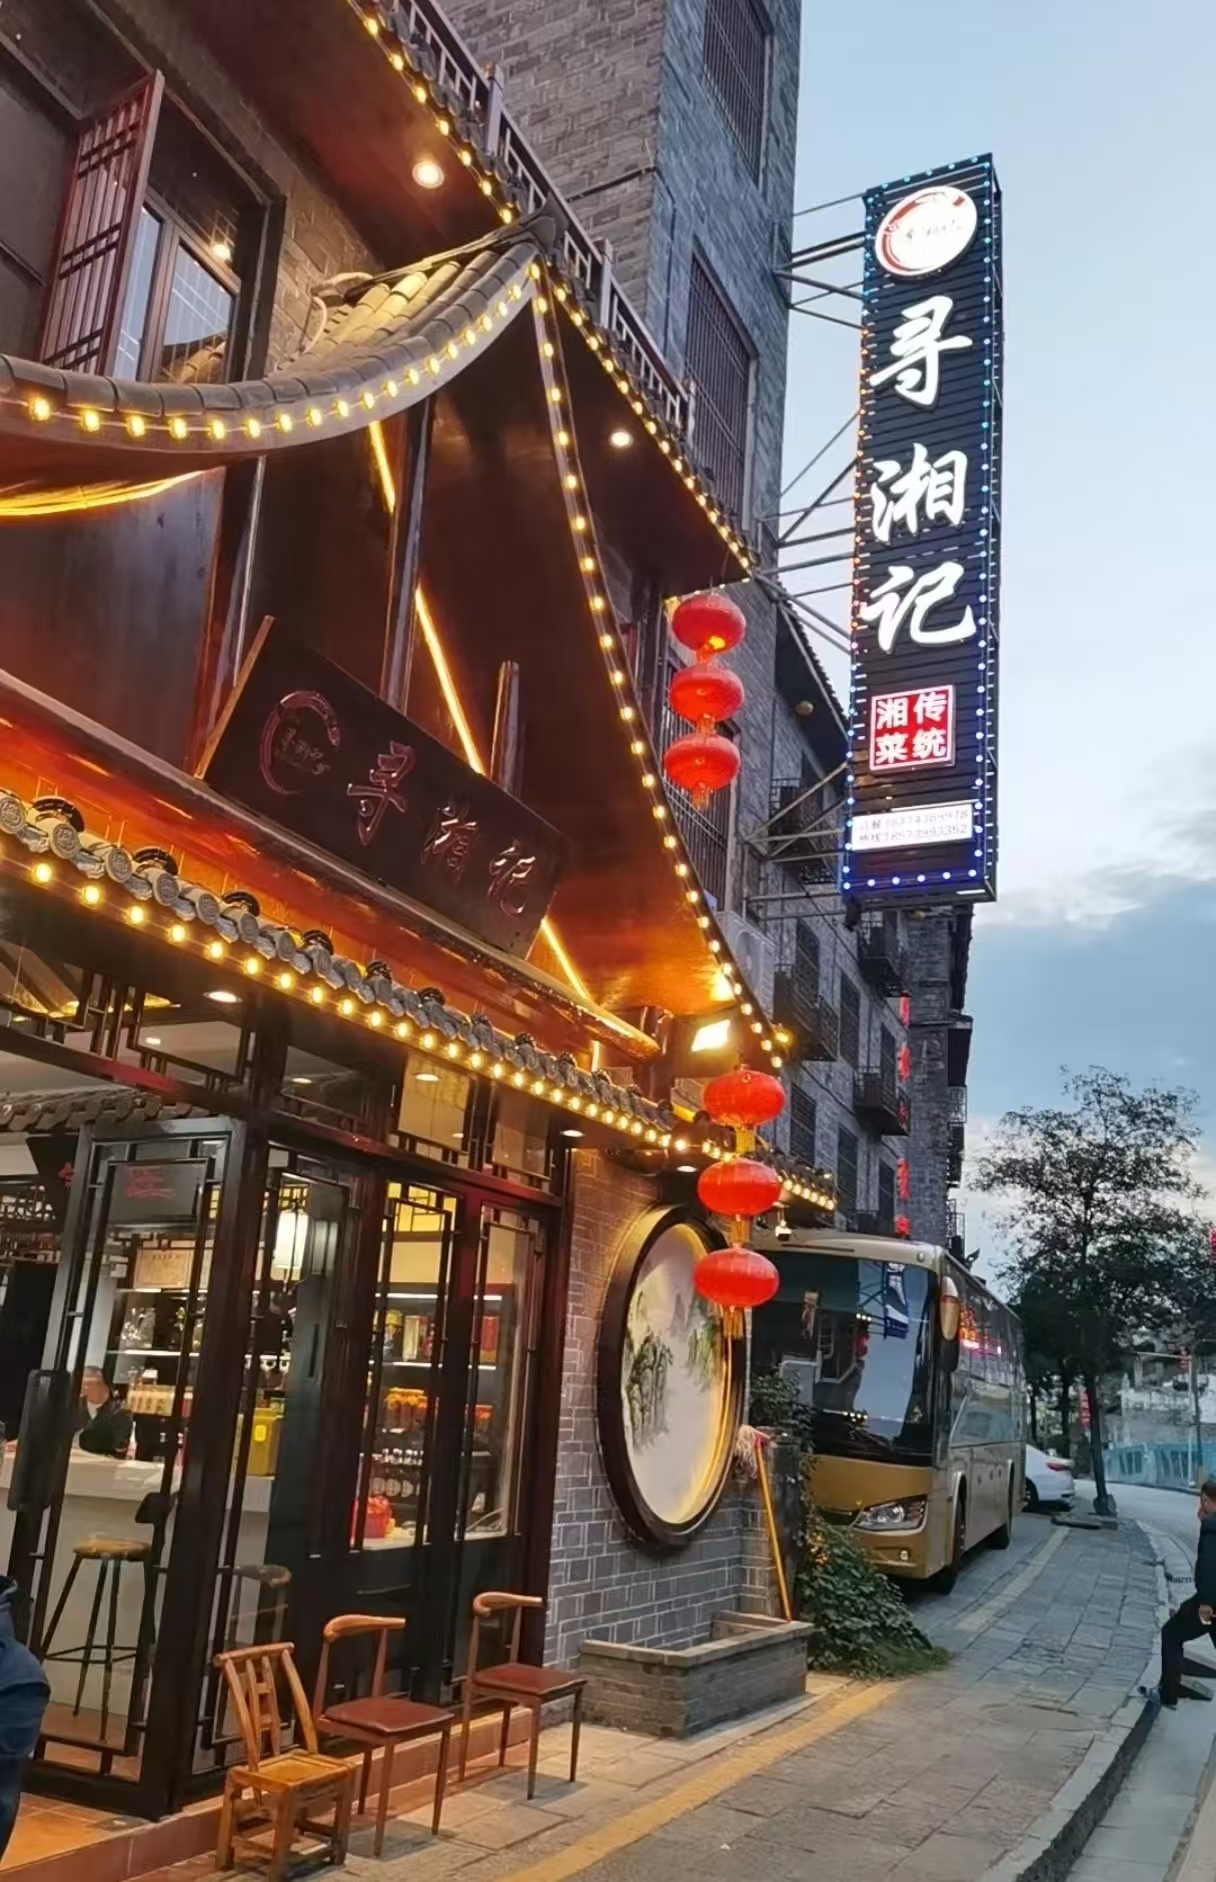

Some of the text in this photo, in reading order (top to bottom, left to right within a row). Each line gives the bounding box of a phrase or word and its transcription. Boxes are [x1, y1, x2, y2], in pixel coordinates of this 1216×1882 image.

[860, 295, 976, 651] 寻湘记
[876, 697, 909, 764] 湘菜
[912, 692, 947, 759] 传统
